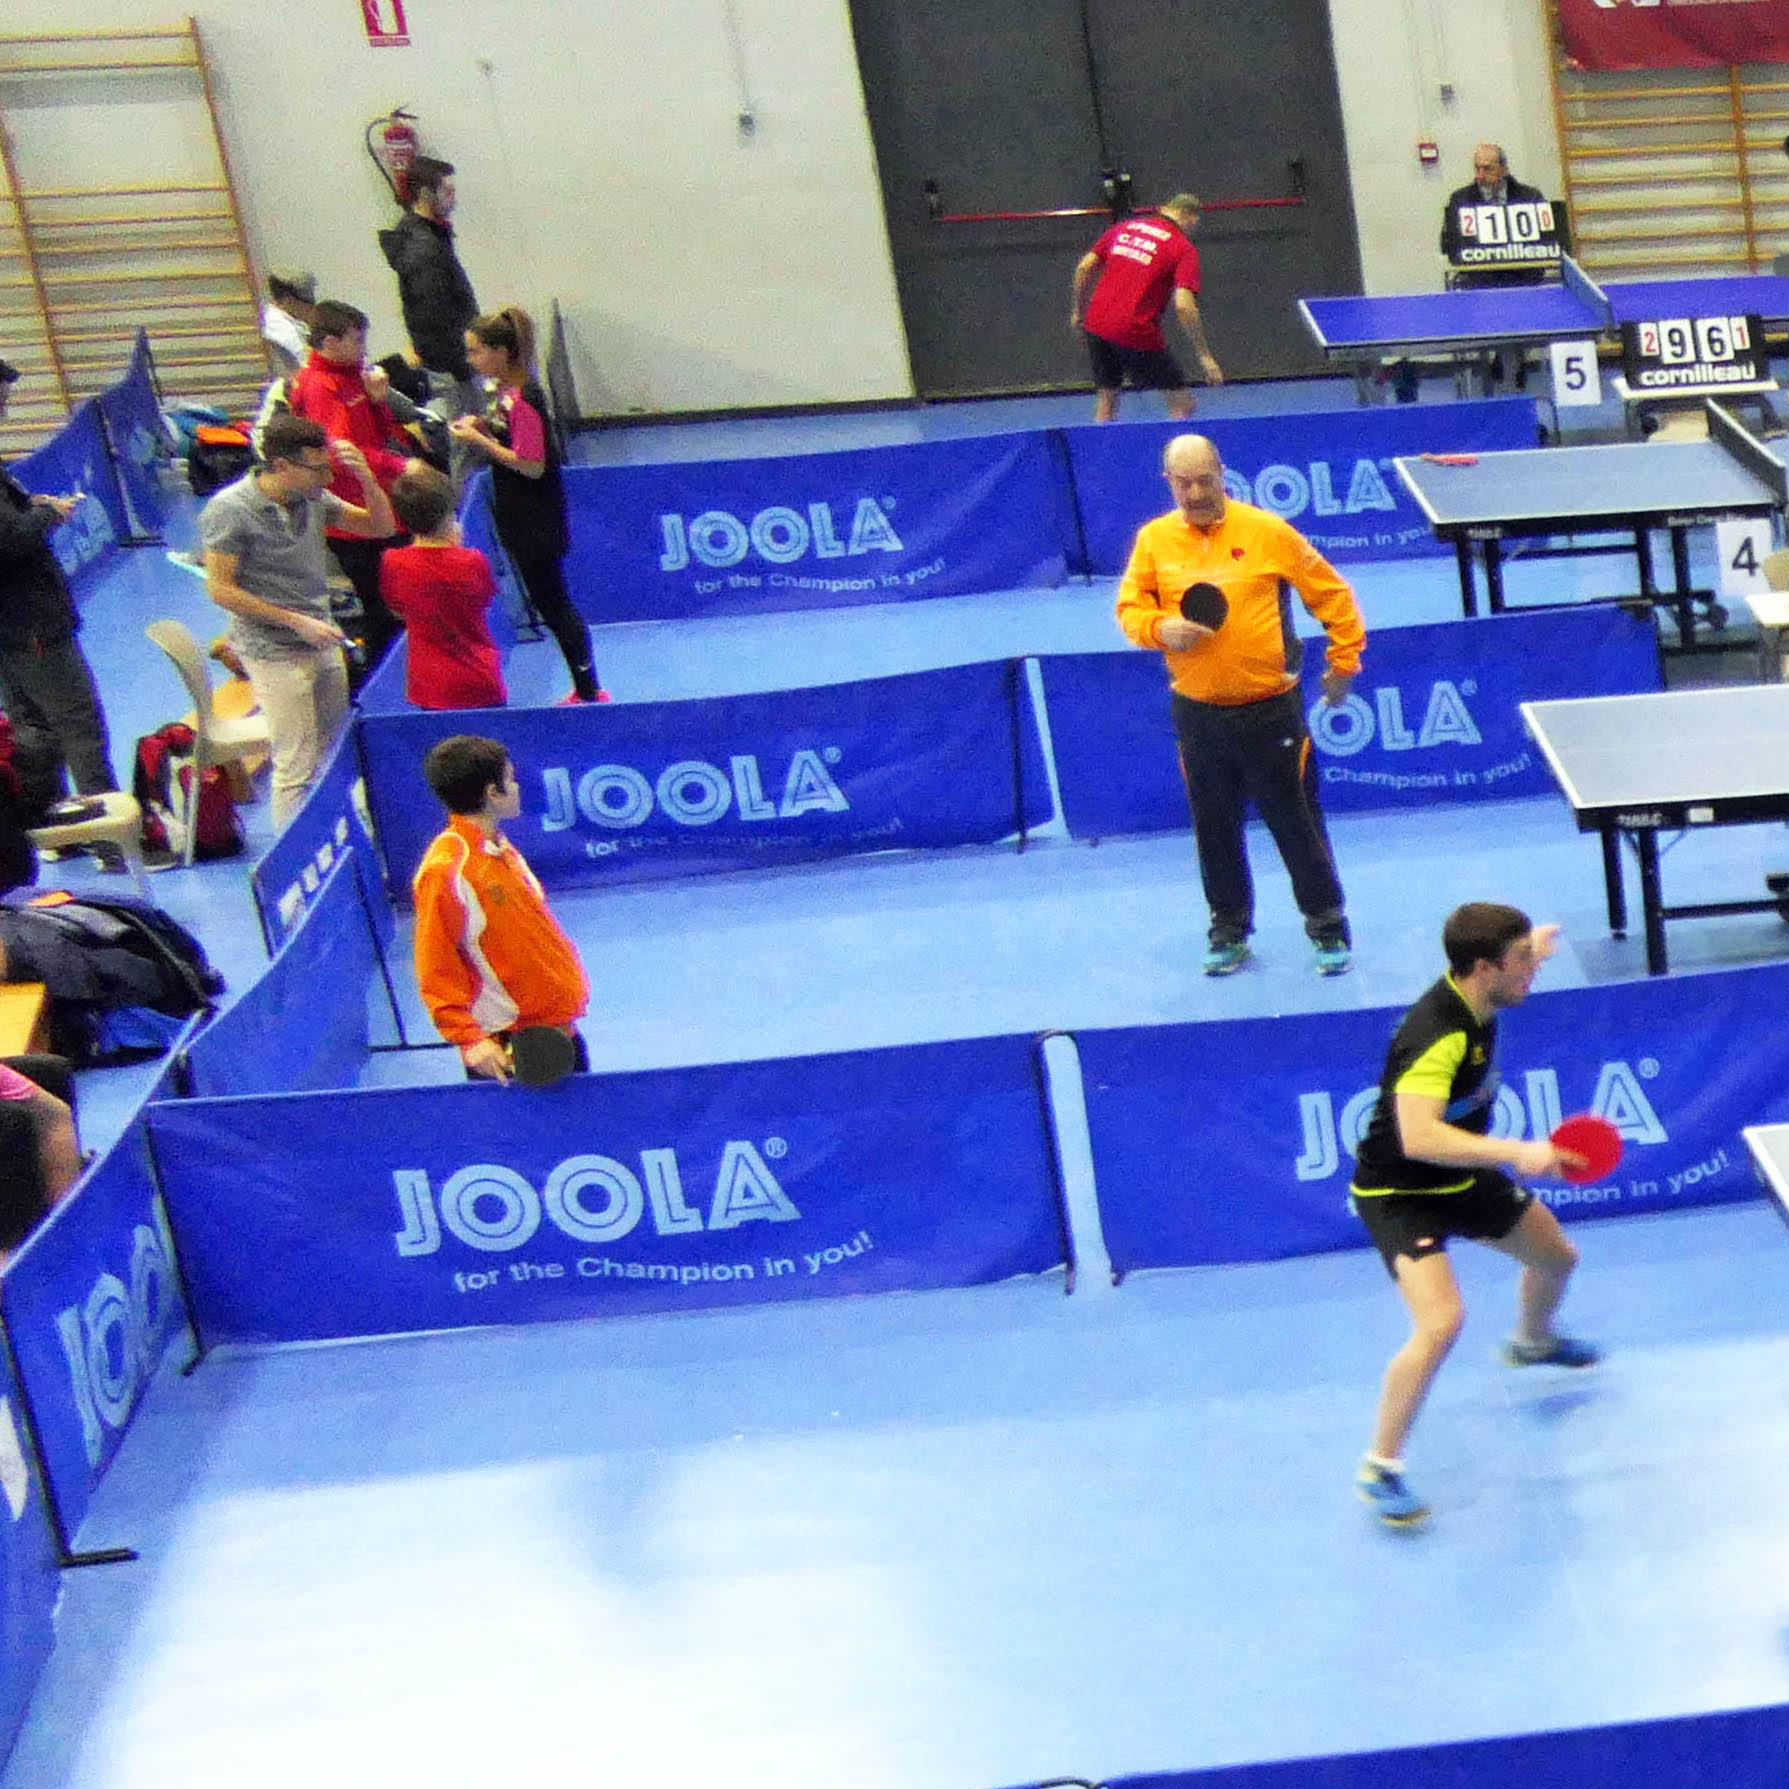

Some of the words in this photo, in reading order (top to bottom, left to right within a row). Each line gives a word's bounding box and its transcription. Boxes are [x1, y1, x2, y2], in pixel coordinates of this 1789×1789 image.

[1464, 215, 1474, 234] 2
[1516, 211, 1532, 238] 0
[1461, 244, 1560, 262] cornilleau
[1644, 331, 1656, 354] 2
[1667, 328, 1687, 358] 9
[1707, 326, 1726, 356] 6
[1565, 356, 1587, 391] 5
[1640, 362, 1756, 386] cornilleau
[660, 498, 903, 571] JOOLA
[1733, 536, 1760, 577] 4
[542, 750, 850, 832] JOOLA
[1323, 766, 1447, 789] Champion
[1455, 770, 1477, 785] in
[1631, 1180, 1659, 1199] in
[1662, 1150, 1730, 1195] you!
[394, 1140, 800, 1258] JOOLA
[453, 1261, 499, 1294] for
[507, 1258, 566, 1282] the
[576, 1253, 753, 1287] Champion
[764, 1256, 796, 1277] in
[803, 1231, 875, 1278] you!
